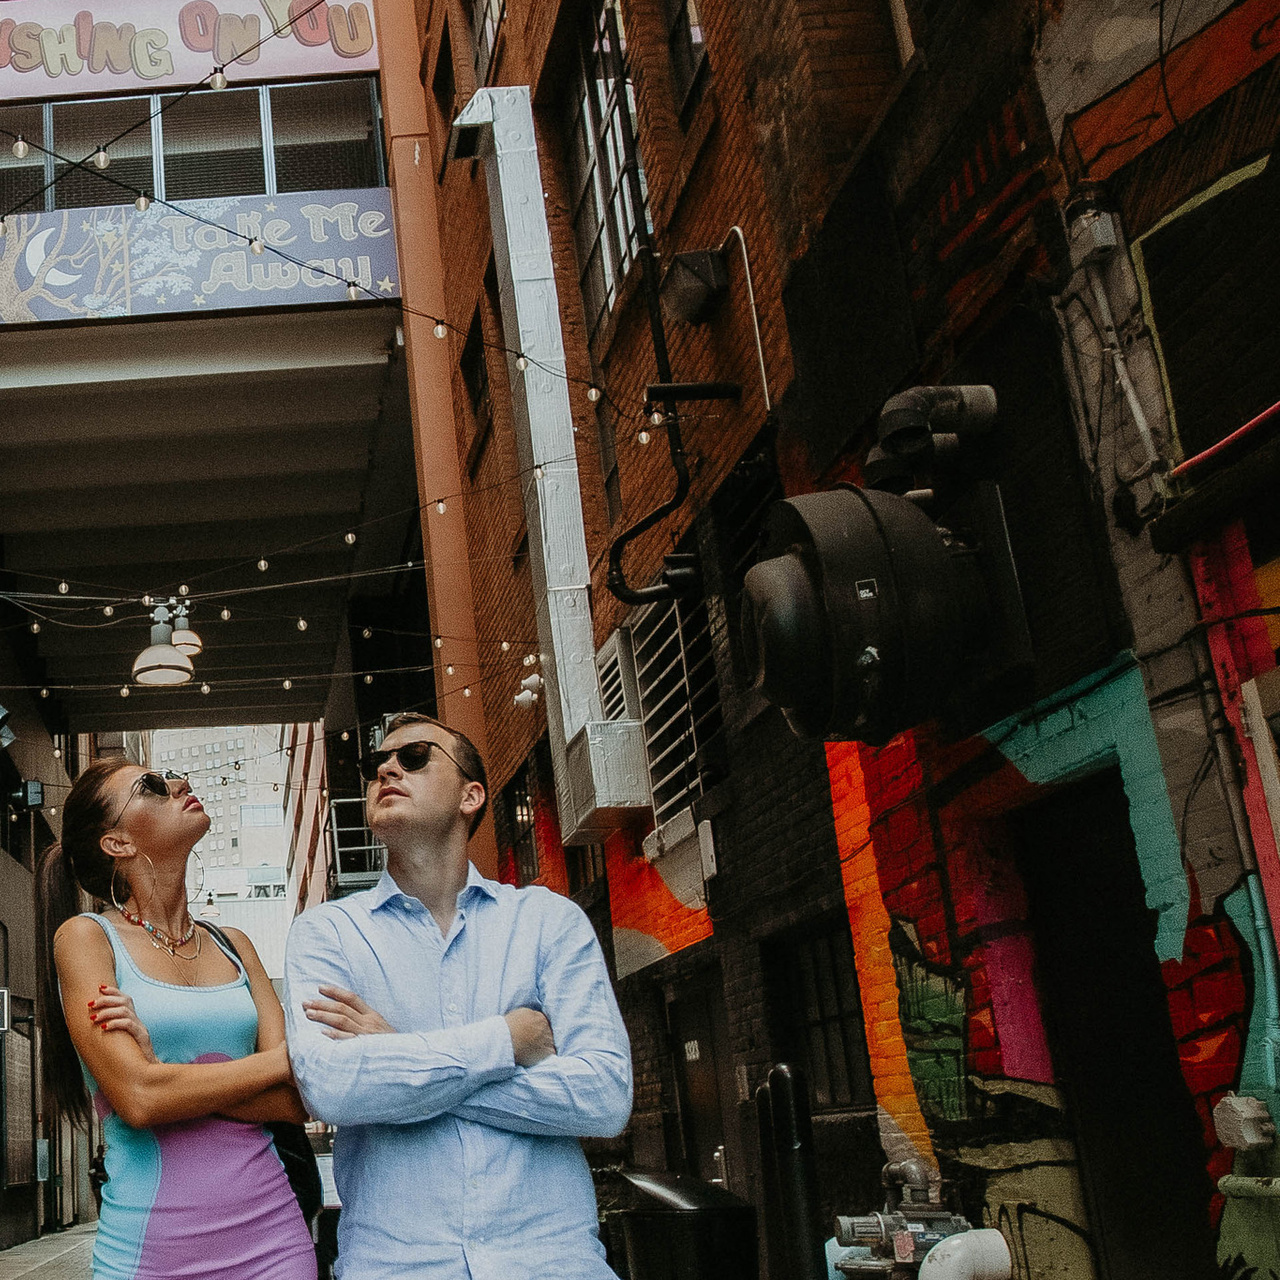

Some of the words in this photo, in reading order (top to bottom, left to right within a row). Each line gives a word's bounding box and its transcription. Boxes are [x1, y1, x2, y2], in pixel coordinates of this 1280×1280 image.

[178, 0, 262, 66] ON
[300, 201, 392, 240] Me
[201, 251, 373, 296] Away
